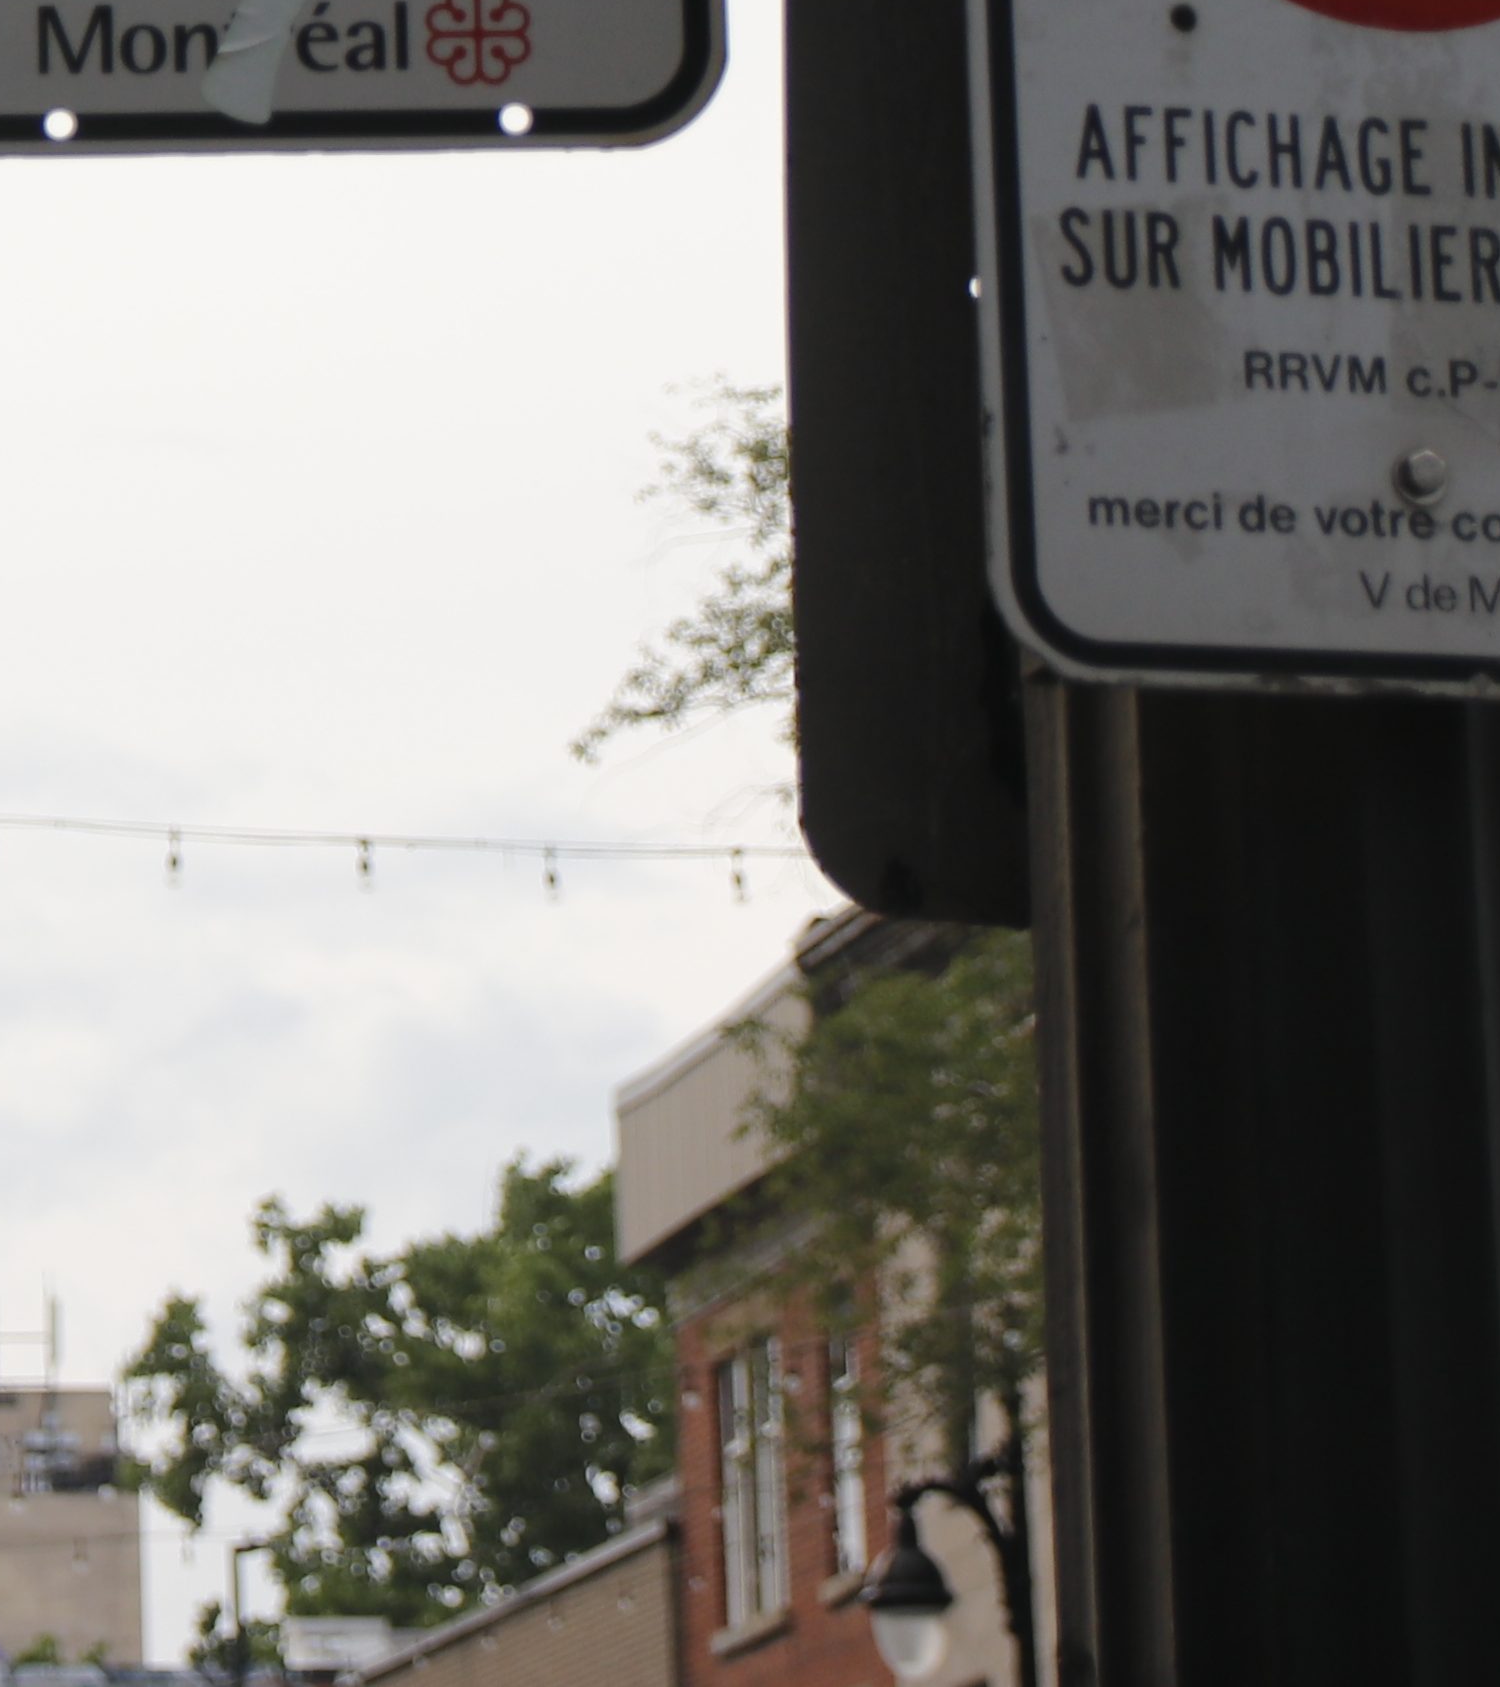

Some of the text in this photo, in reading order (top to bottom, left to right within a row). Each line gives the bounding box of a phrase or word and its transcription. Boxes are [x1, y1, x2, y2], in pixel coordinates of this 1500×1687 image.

[36, 0, 411, 76] Monéal
[1075, 102, 1434, 199] AFFICHAGE
[1058, 206, 1182, 291] SUR
[1243, 349, 1388, 395] RRVM
[1087, 491, 1224, 533] merci
[1237, 493, 1298, 535] de
[1314, 501, 1440, 543] votre
[1358, 570, 1391, 611] V
[1404, 573, 1459, 613] de
